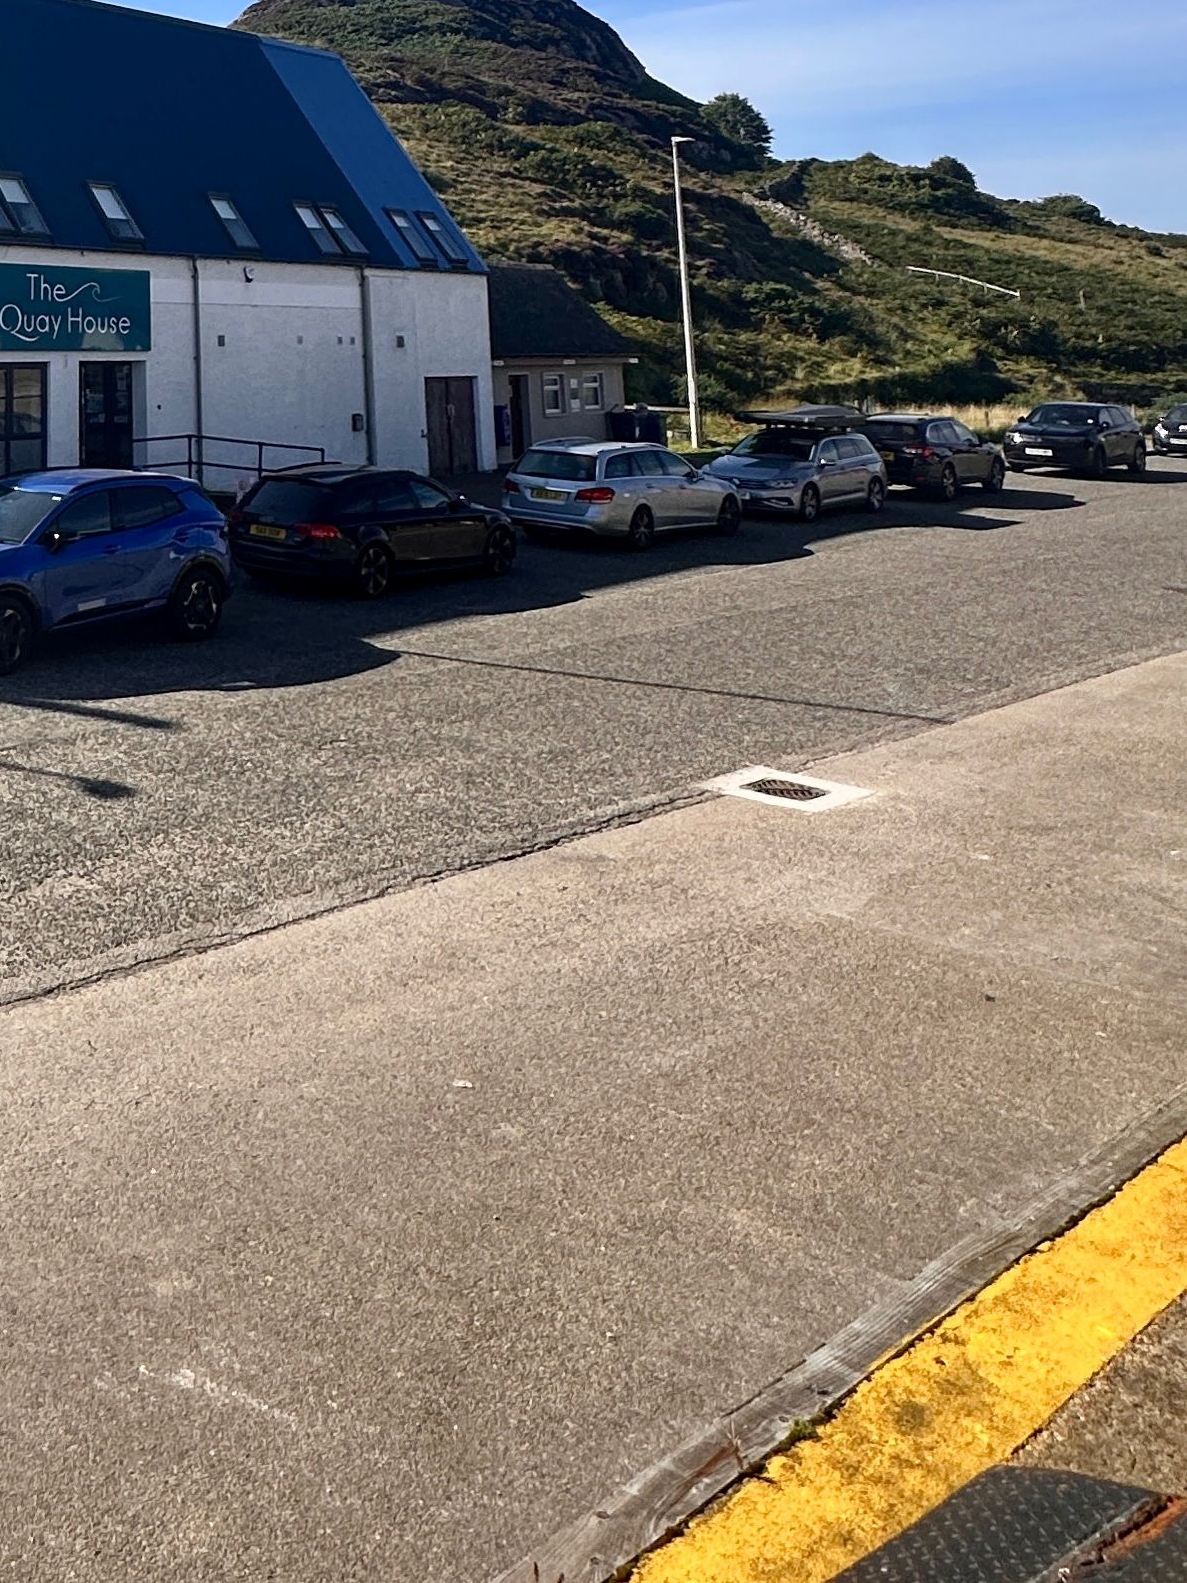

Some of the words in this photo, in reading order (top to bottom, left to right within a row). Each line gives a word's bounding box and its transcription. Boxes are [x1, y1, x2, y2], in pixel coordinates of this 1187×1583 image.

[26, 273, 66, 302] The
[0, 304, 62, 342] Quay
[67, 307, 131, 334] House
